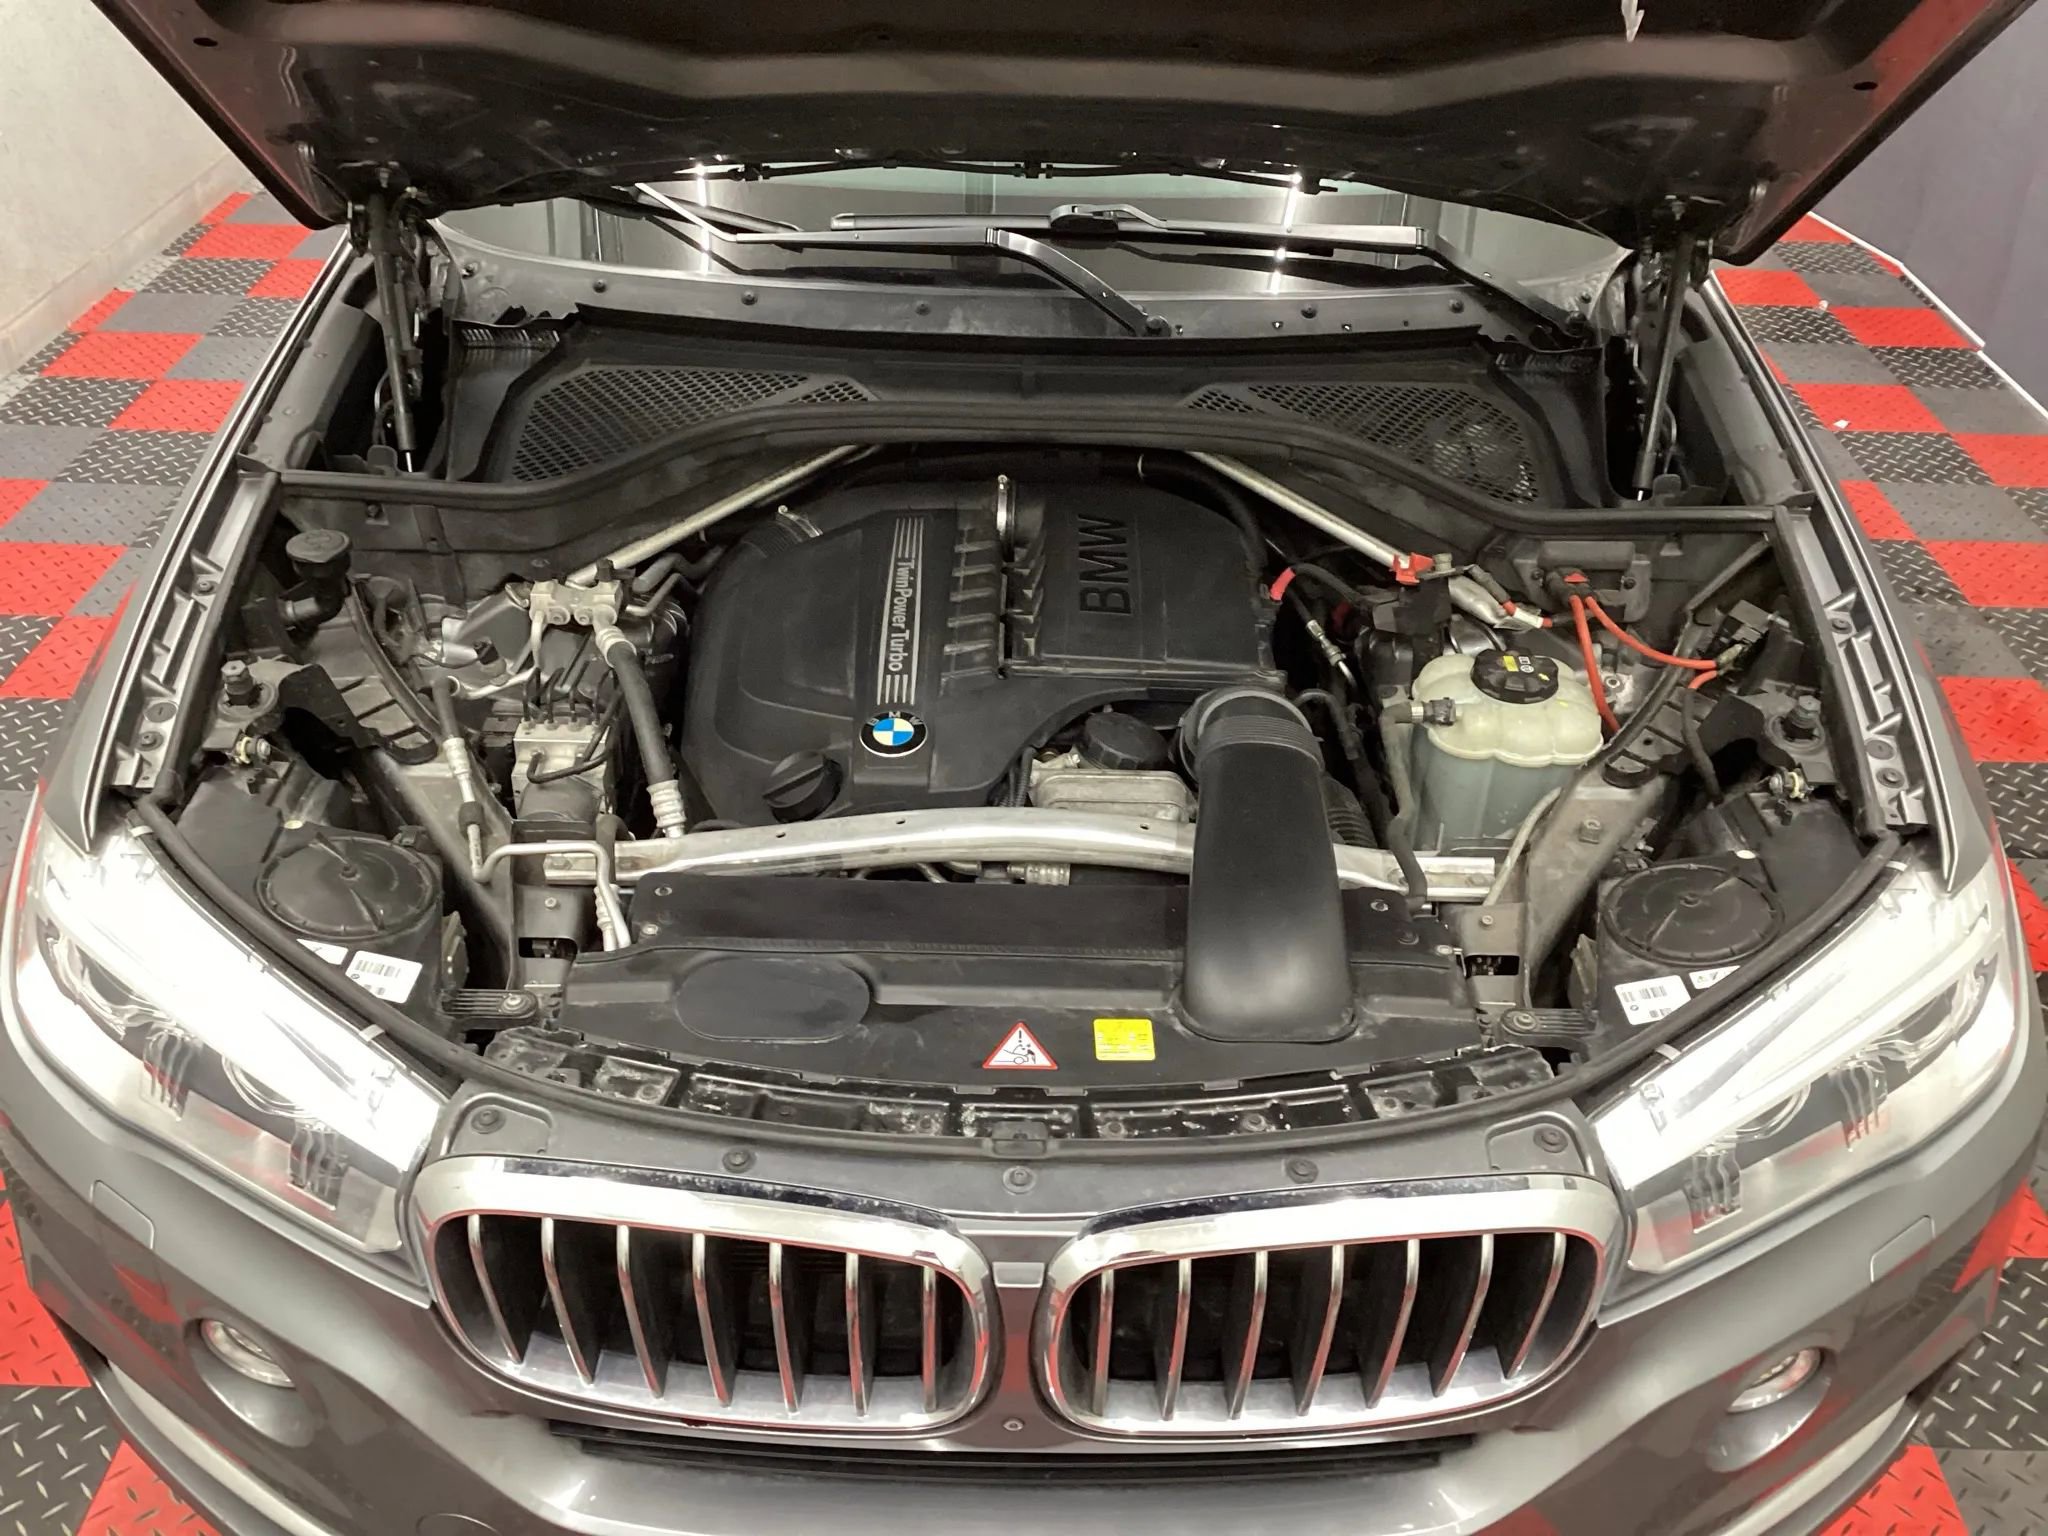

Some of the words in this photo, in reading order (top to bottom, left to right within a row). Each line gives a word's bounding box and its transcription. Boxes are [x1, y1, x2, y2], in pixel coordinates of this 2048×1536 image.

[1078, 514, 1131, 615] BMW
[891, 560, 915, 629] TwinPower
[888, 629, 910, 672] Turbo
[866, 711, 924, 726] BMW
